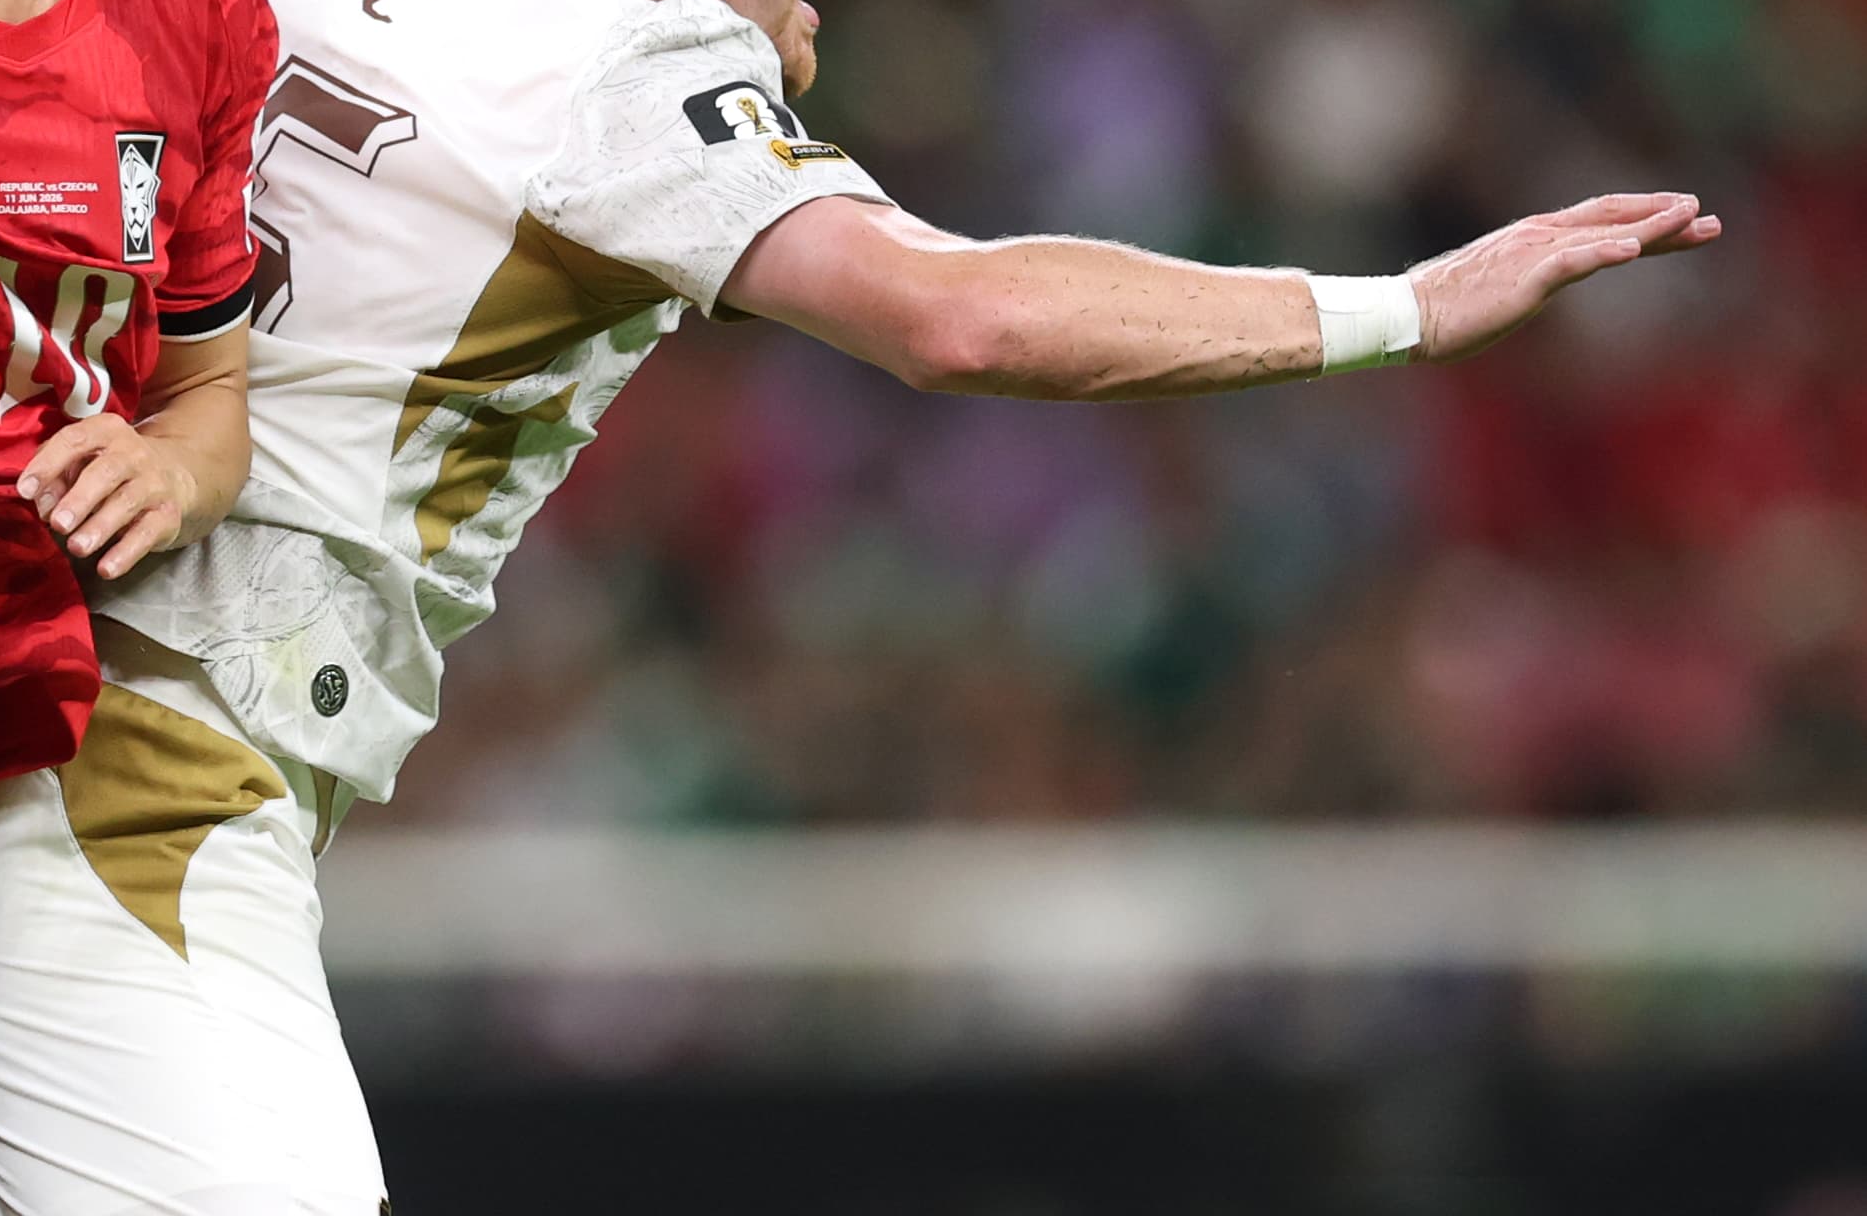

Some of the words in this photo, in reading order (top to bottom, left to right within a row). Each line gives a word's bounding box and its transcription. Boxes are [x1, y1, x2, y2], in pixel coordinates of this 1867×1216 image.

[791, 146, 836, 157] DEBUT
[0, 182, 45, 192] REPUBLIC
[57, 182, 99, 192] CZECHIA
[4, 194, 16, 203] 11
[18, 194, 37, 203] JUN
[39, 194, 63, 202] 2026
[50, 204, 88, 214] MEXICO
